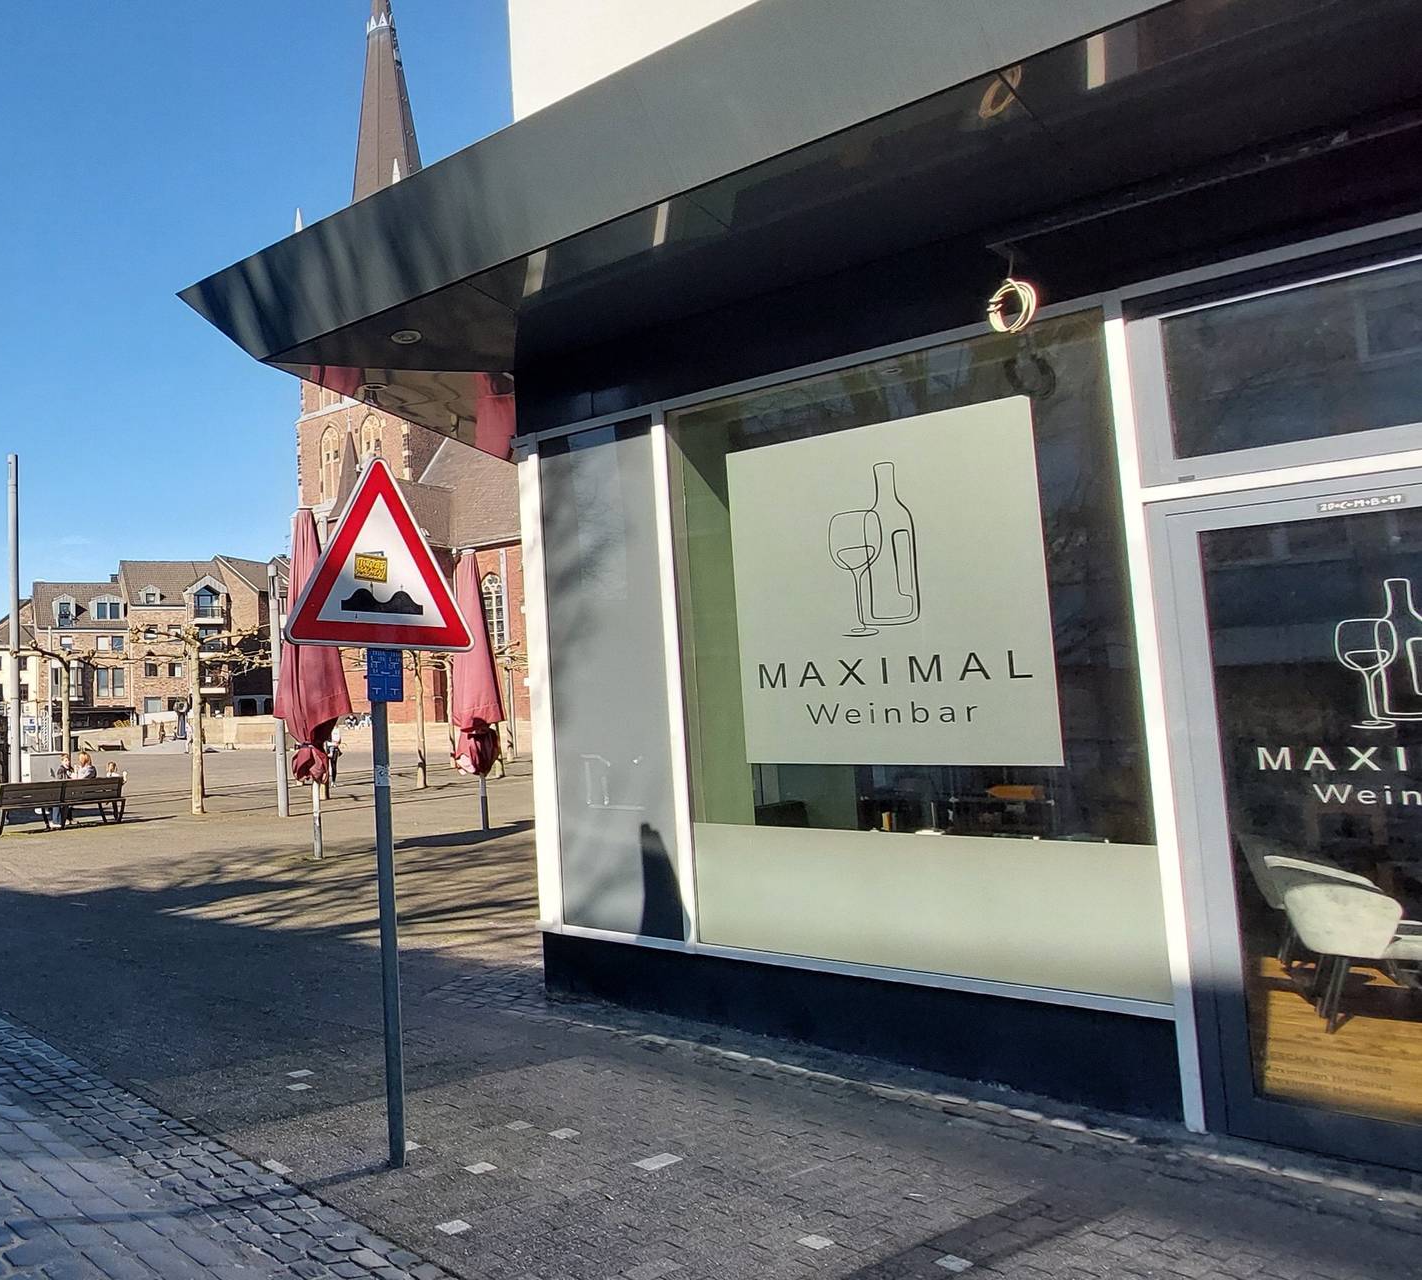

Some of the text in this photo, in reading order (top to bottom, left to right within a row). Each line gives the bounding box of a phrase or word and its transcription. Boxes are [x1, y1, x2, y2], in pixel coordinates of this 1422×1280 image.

[757, 649, 1034, 690] MAXIMAL
[806, 700, 979, 726] Weinbar
[1256, 745, 1408, 772] MAXI
[1312, 783, 1422, 806] Wein
